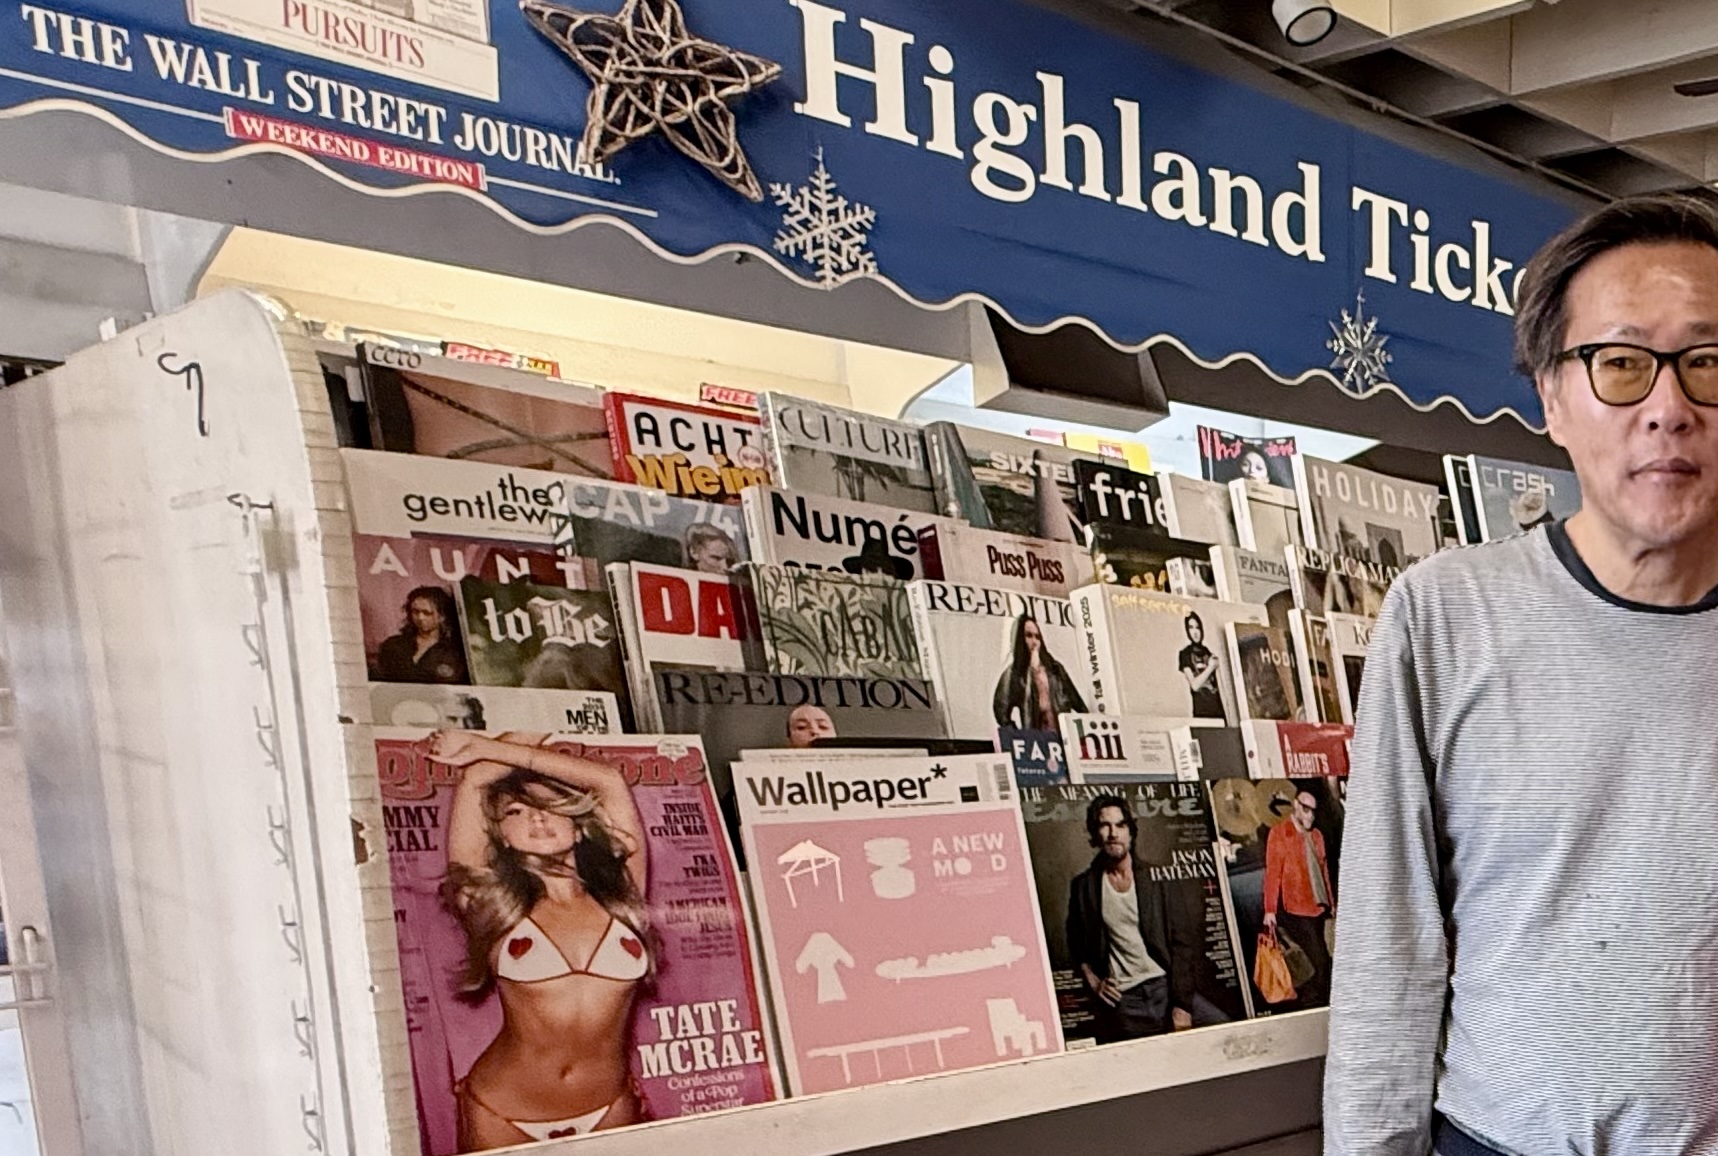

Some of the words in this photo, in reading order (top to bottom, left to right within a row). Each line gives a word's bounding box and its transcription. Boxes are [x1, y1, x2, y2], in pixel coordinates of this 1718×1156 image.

[283, 1, 425, 68] PURSUITS
[22, 5, 134, 72] THE
[145, 34, 275, 106] WALL
[286, 70, 447, 147] STREET
[793, 1, 1326, 262] Highland
[239, 113, 371, 165] WEEKEND
[378, 145, 475, 187] EDITION
[634, 412, 753, 456] ACHT
[498, 473, 552, 507] the
[1313, 465, 1438, 522] HOLIDAY
[1480, 465, 1555, 497] crash
[569, 482, 671, 528] CAP
[986, 545, 1026, 581] Puss
[1026, 552, 1065, 584] Puss
[482, 595, 533, 643] to
[1079, 597, 1093, 628] 2025
[659, 671, 933, 710] RE-EDITION
[566, 709, 609, 725] MEN
[1012, 738, 1064, 763] FAR
[1077, 719, 1129, 761] hii
[1286, 750, 1331, 775] RABBIT'S
[663, 802, 702, 814] INSIDE
[1064, 785, 1127, 803] MEANING
[1136, 785, 1158, 801] OF
[1169, 783, 1200, 800] LIFE
[650, 824, 677, 838] CIVIL
[678, 822, 709, 837] WAR
[932, 836, 951, 856] A
[953, 832, 1004, 854] NEW
[682, 865, 720, 879] TWIGS
[1149, 863, 1217, 884] BATEMAN
[1169, 849, 1214, 867] JASON
[650, 999, 741, 1041] TATE
[636, 1031, 766, 1080] MCRAE
[668, 1068, 746, 1092] Confessions
[680, 1091, 695, 1104] of
[706, 1083, 739, 1101] Pop
